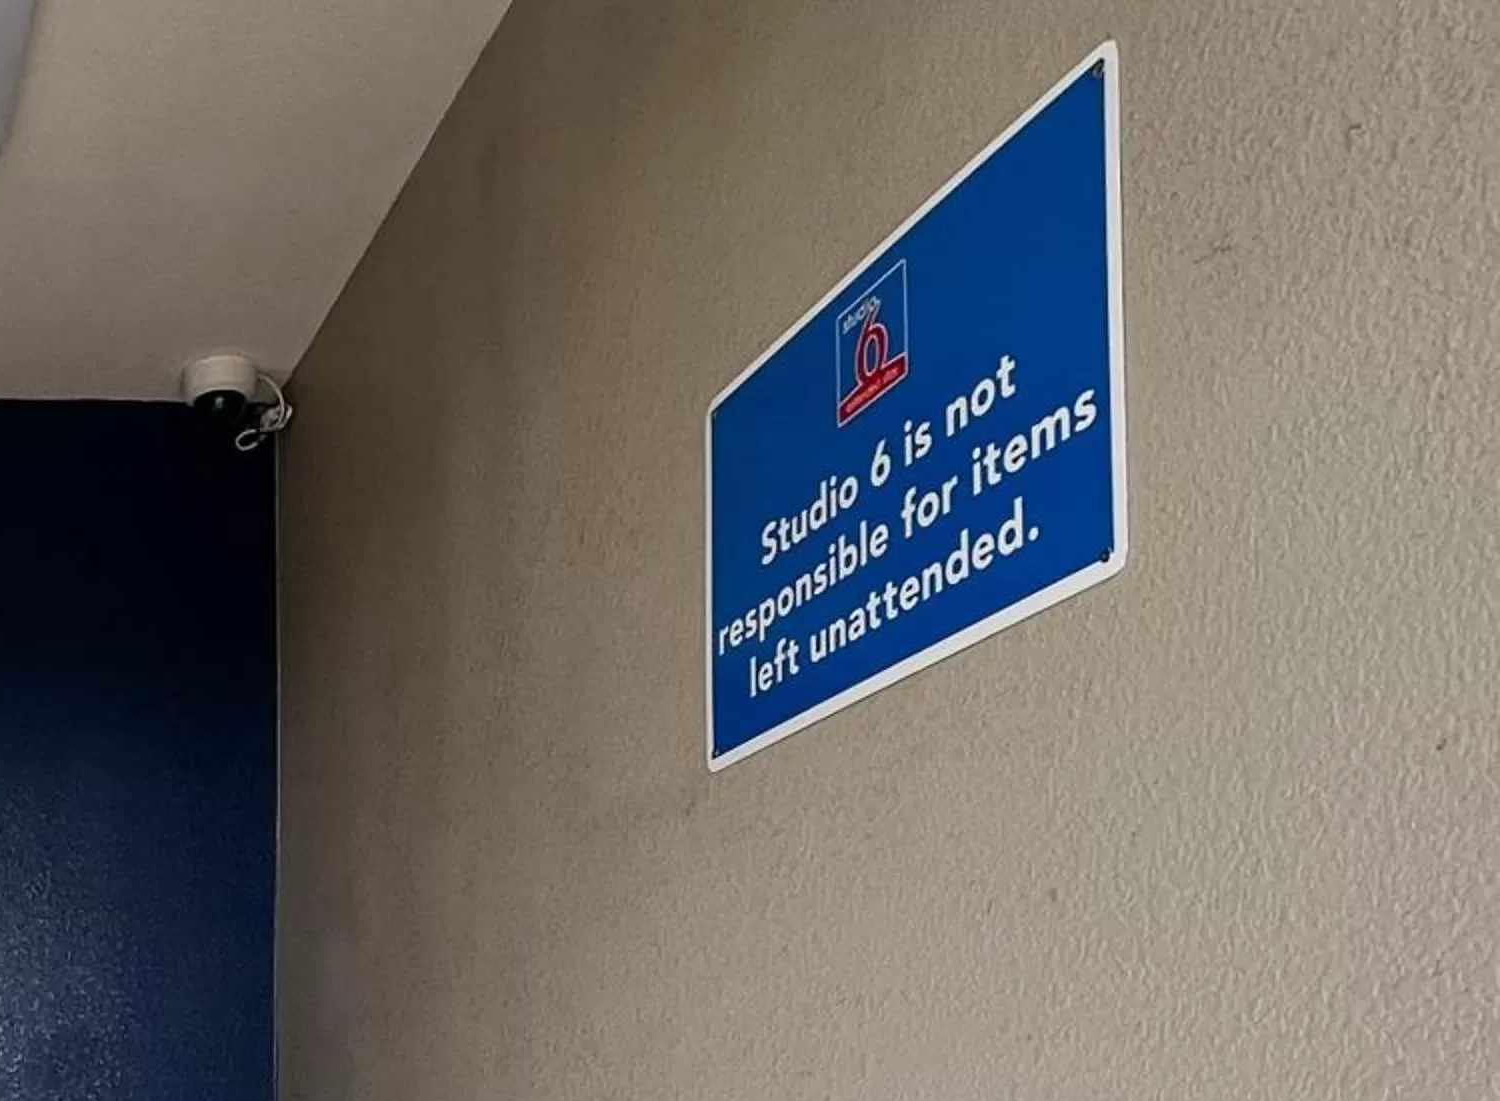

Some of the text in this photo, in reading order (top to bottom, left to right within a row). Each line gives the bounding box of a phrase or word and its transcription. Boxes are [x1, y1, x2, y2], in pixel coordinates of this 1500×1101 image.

[717, 519, 889, 656] responsible
[900, 474, 959, 539] for
[971, 386, 1098, 497] items
[761, 474, 859, 567] Studio
[870, 440, 891, 489] 6
[904, 419, 933, 467] is
[945, 352, 1018, 437] not
[749, 497, 1040, 698] left unattended.
